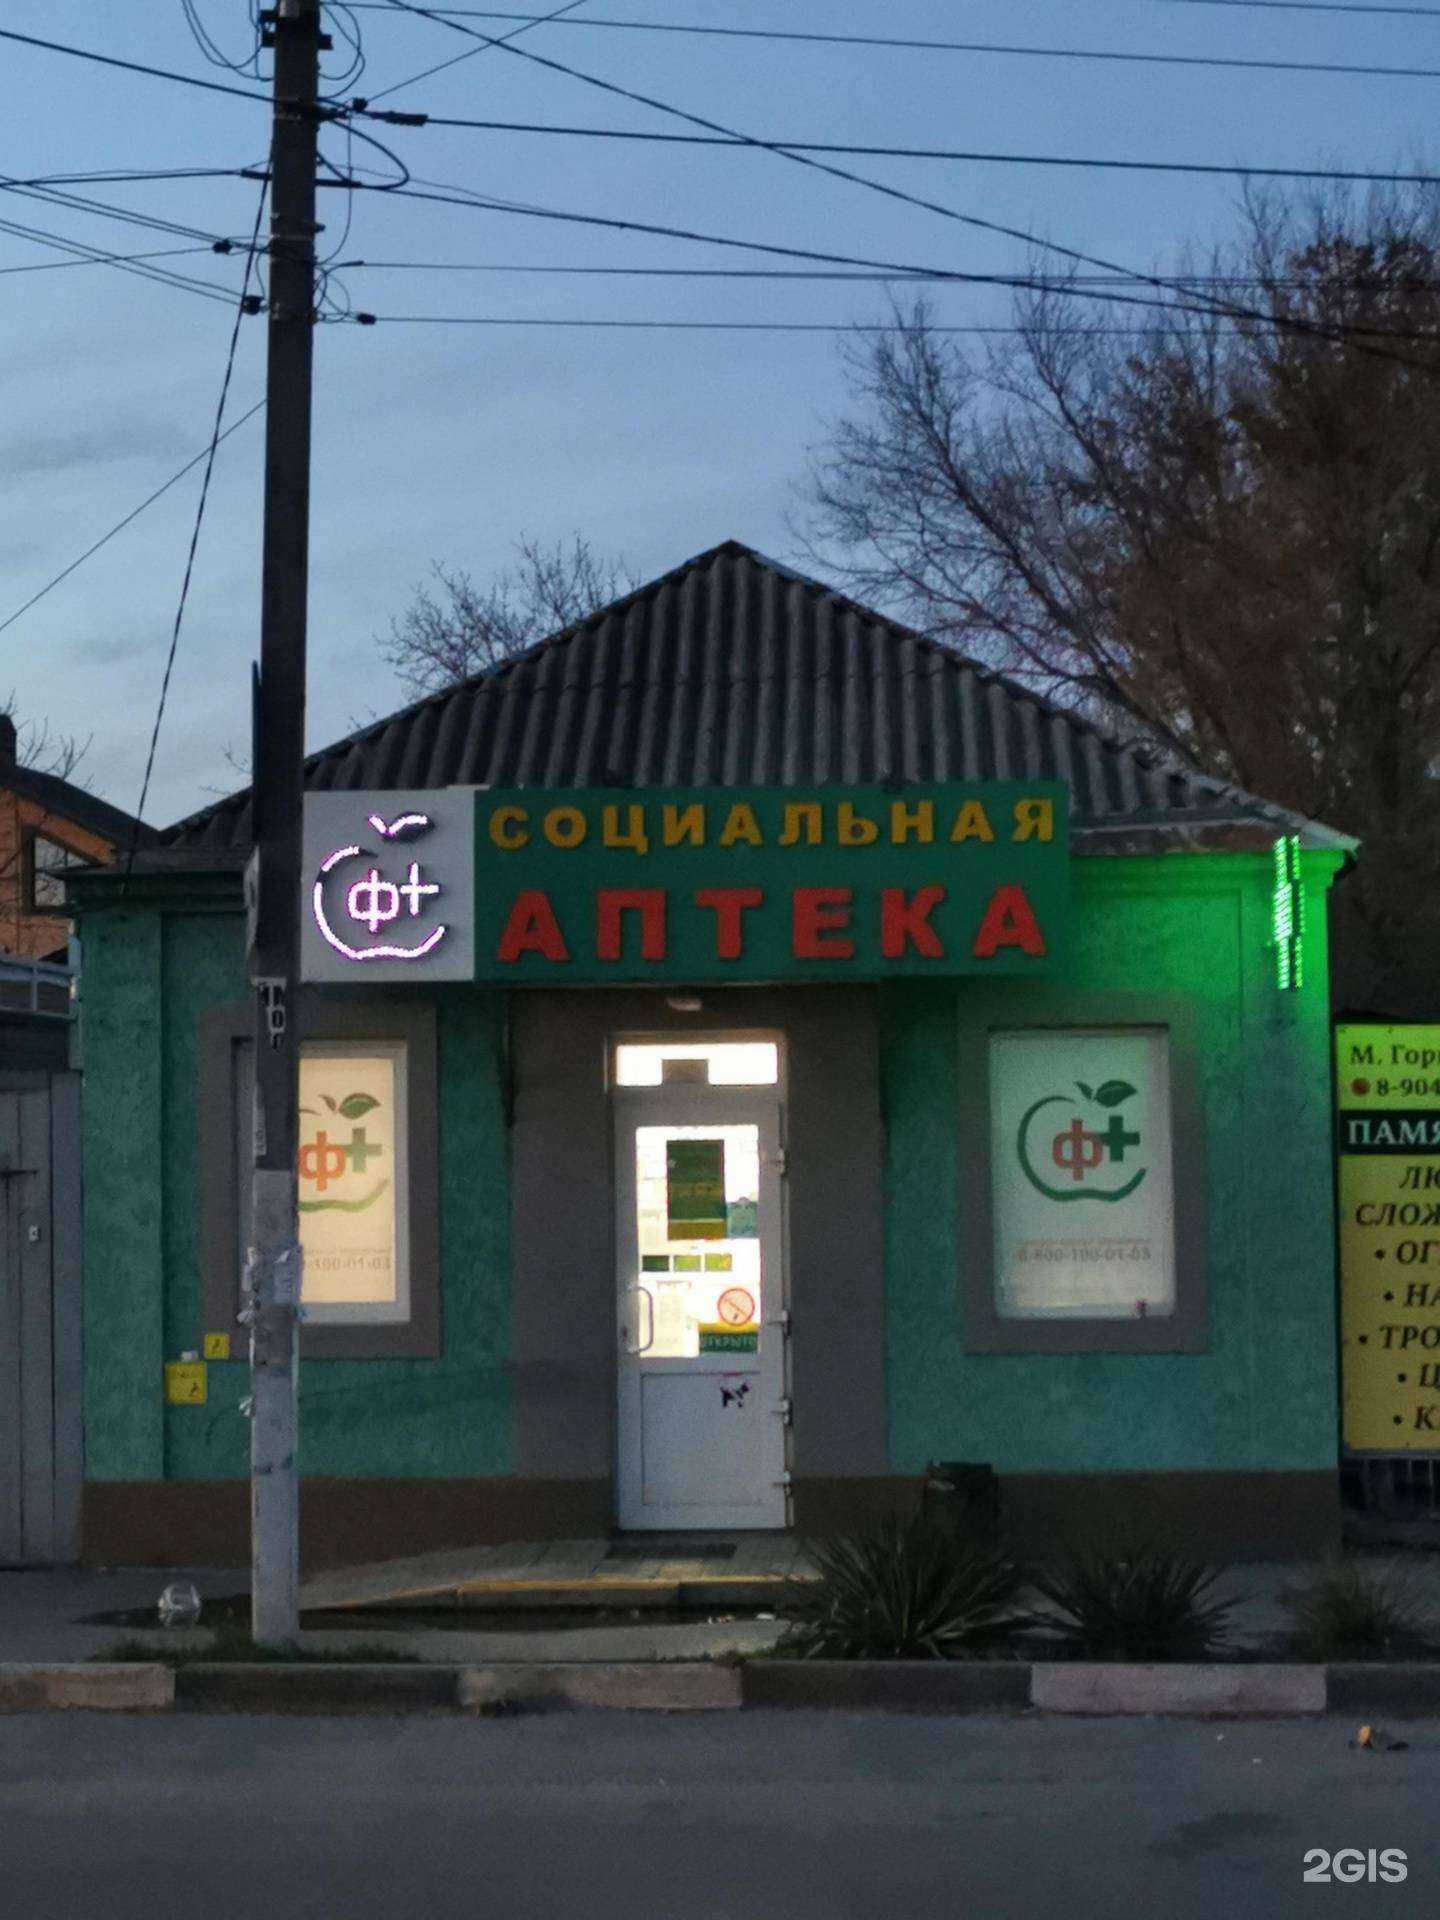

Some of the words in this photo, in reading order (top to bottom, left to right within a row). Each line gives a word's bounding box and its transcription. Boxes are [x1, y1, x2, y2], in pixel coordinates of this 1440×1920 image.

[489, 799, 1054, 853] СОЦИАЛЬНАЯ
[498, 884, 1046, 963] АПТЕКА
[1391, 1044, 1440, 1070] Гор
